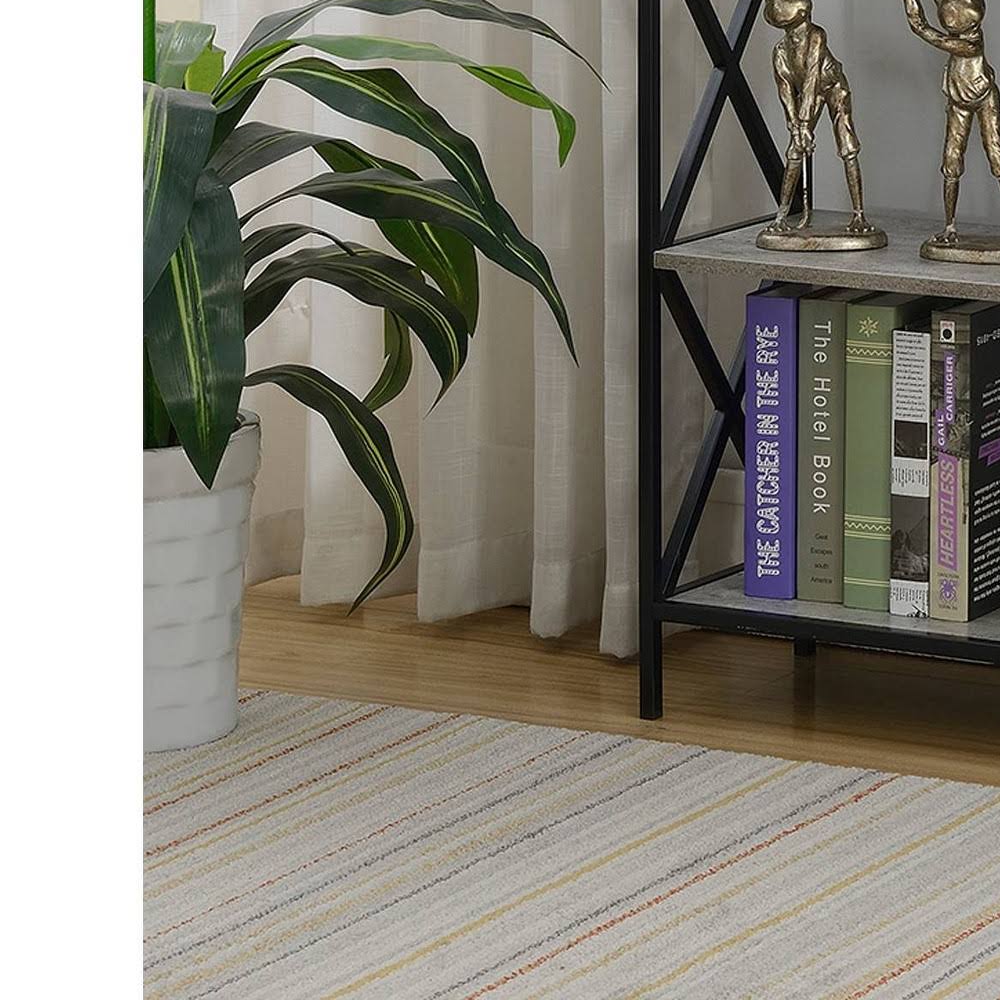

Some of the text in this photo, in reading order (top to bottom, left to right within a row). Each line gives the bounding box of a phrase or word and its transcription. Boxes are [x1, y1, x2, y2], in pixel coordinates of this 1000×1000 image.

[812, 321, 831, 514] The Hotel Book
[937, 414, 945, 447] GAIL
[946, 356, 954, 422] CARRIGER
[755, 325, 780, 577] THE CATCHER IN THE RYE
[939, 459, 955, 567] HEARTLESS
